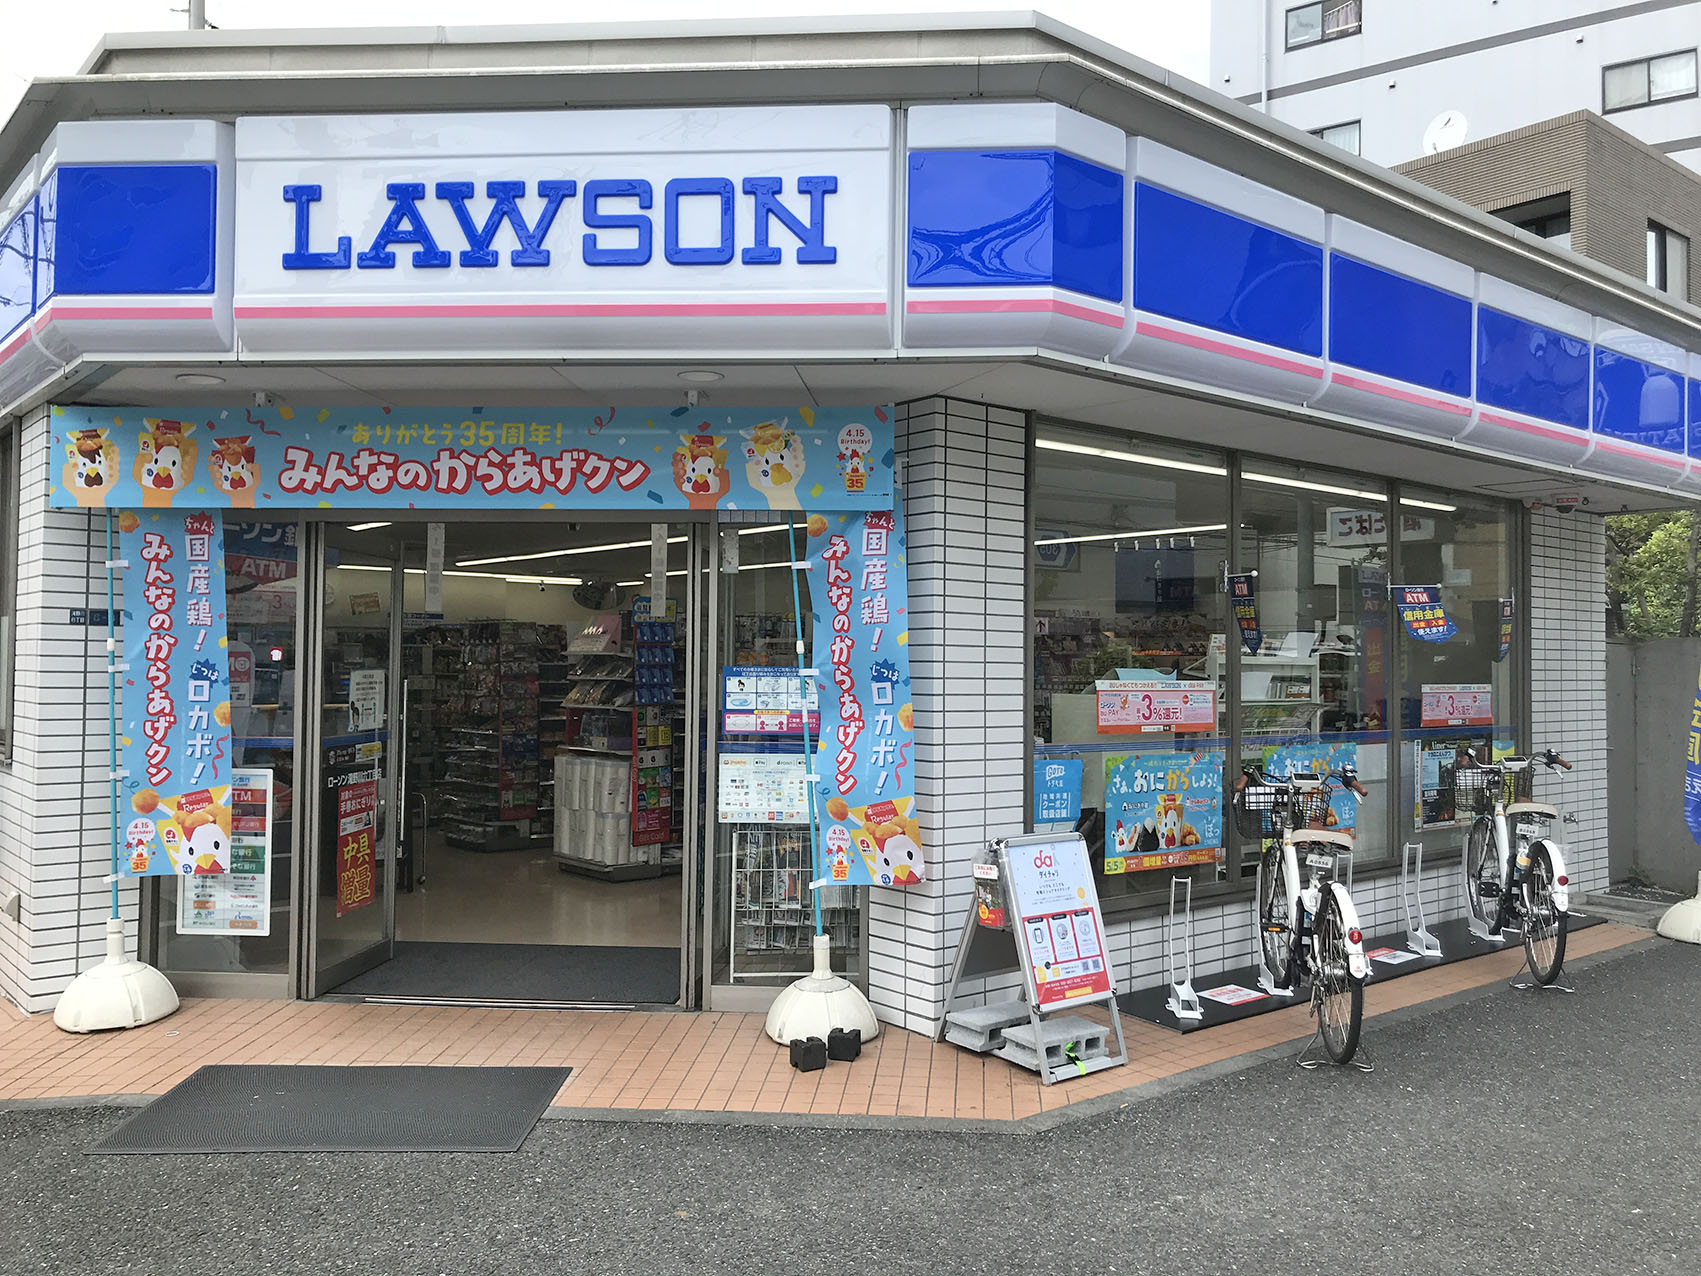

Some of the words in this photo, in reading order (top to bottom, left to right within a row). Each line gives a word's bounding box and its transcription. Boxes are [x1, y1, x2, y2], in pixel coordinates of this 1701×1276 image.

[282, 175, 838, 270] LAWSON
[351, 420, 563, 447] ありがとう35周年!
[840, 438, 871, 446] Birthday!
[846, 429, 864, 437] 4.15
[279, 446, 650, 495] みんなのからあげクン
[847, 478, 864, 488] 35
[184, 516, 215, 534] ちゃんと
[865, 512, 896, 530] ちゃんと
[240, 558, 286, 579] ATM
[185, 534, 212, 652] 国産鶏!
[860, 528, 889, 652] 国産鶏!
[1235, 583, 1248, 596] ATM
[1406, 593, 1429, 603] ATM
[1403, 609, 1445, 621] 信用金庫
[141, 532, 178, 787] みんなのからあげクン
[822, 535, 865, 795] みんなのからあげクン
[192, 662, 219, 681] じつは
[871, 664, 900, 682] じつは
[186, 680, 214, 785] ロカボ!
[870, 682, 897, 795] ロカボ!
[1042, 801, 1067, 809] クーポン
[132, 861, 147, 871] 35
[833, 869, 847, 878] 35
[1039, 870, 1059, 879] ダイチャリ
